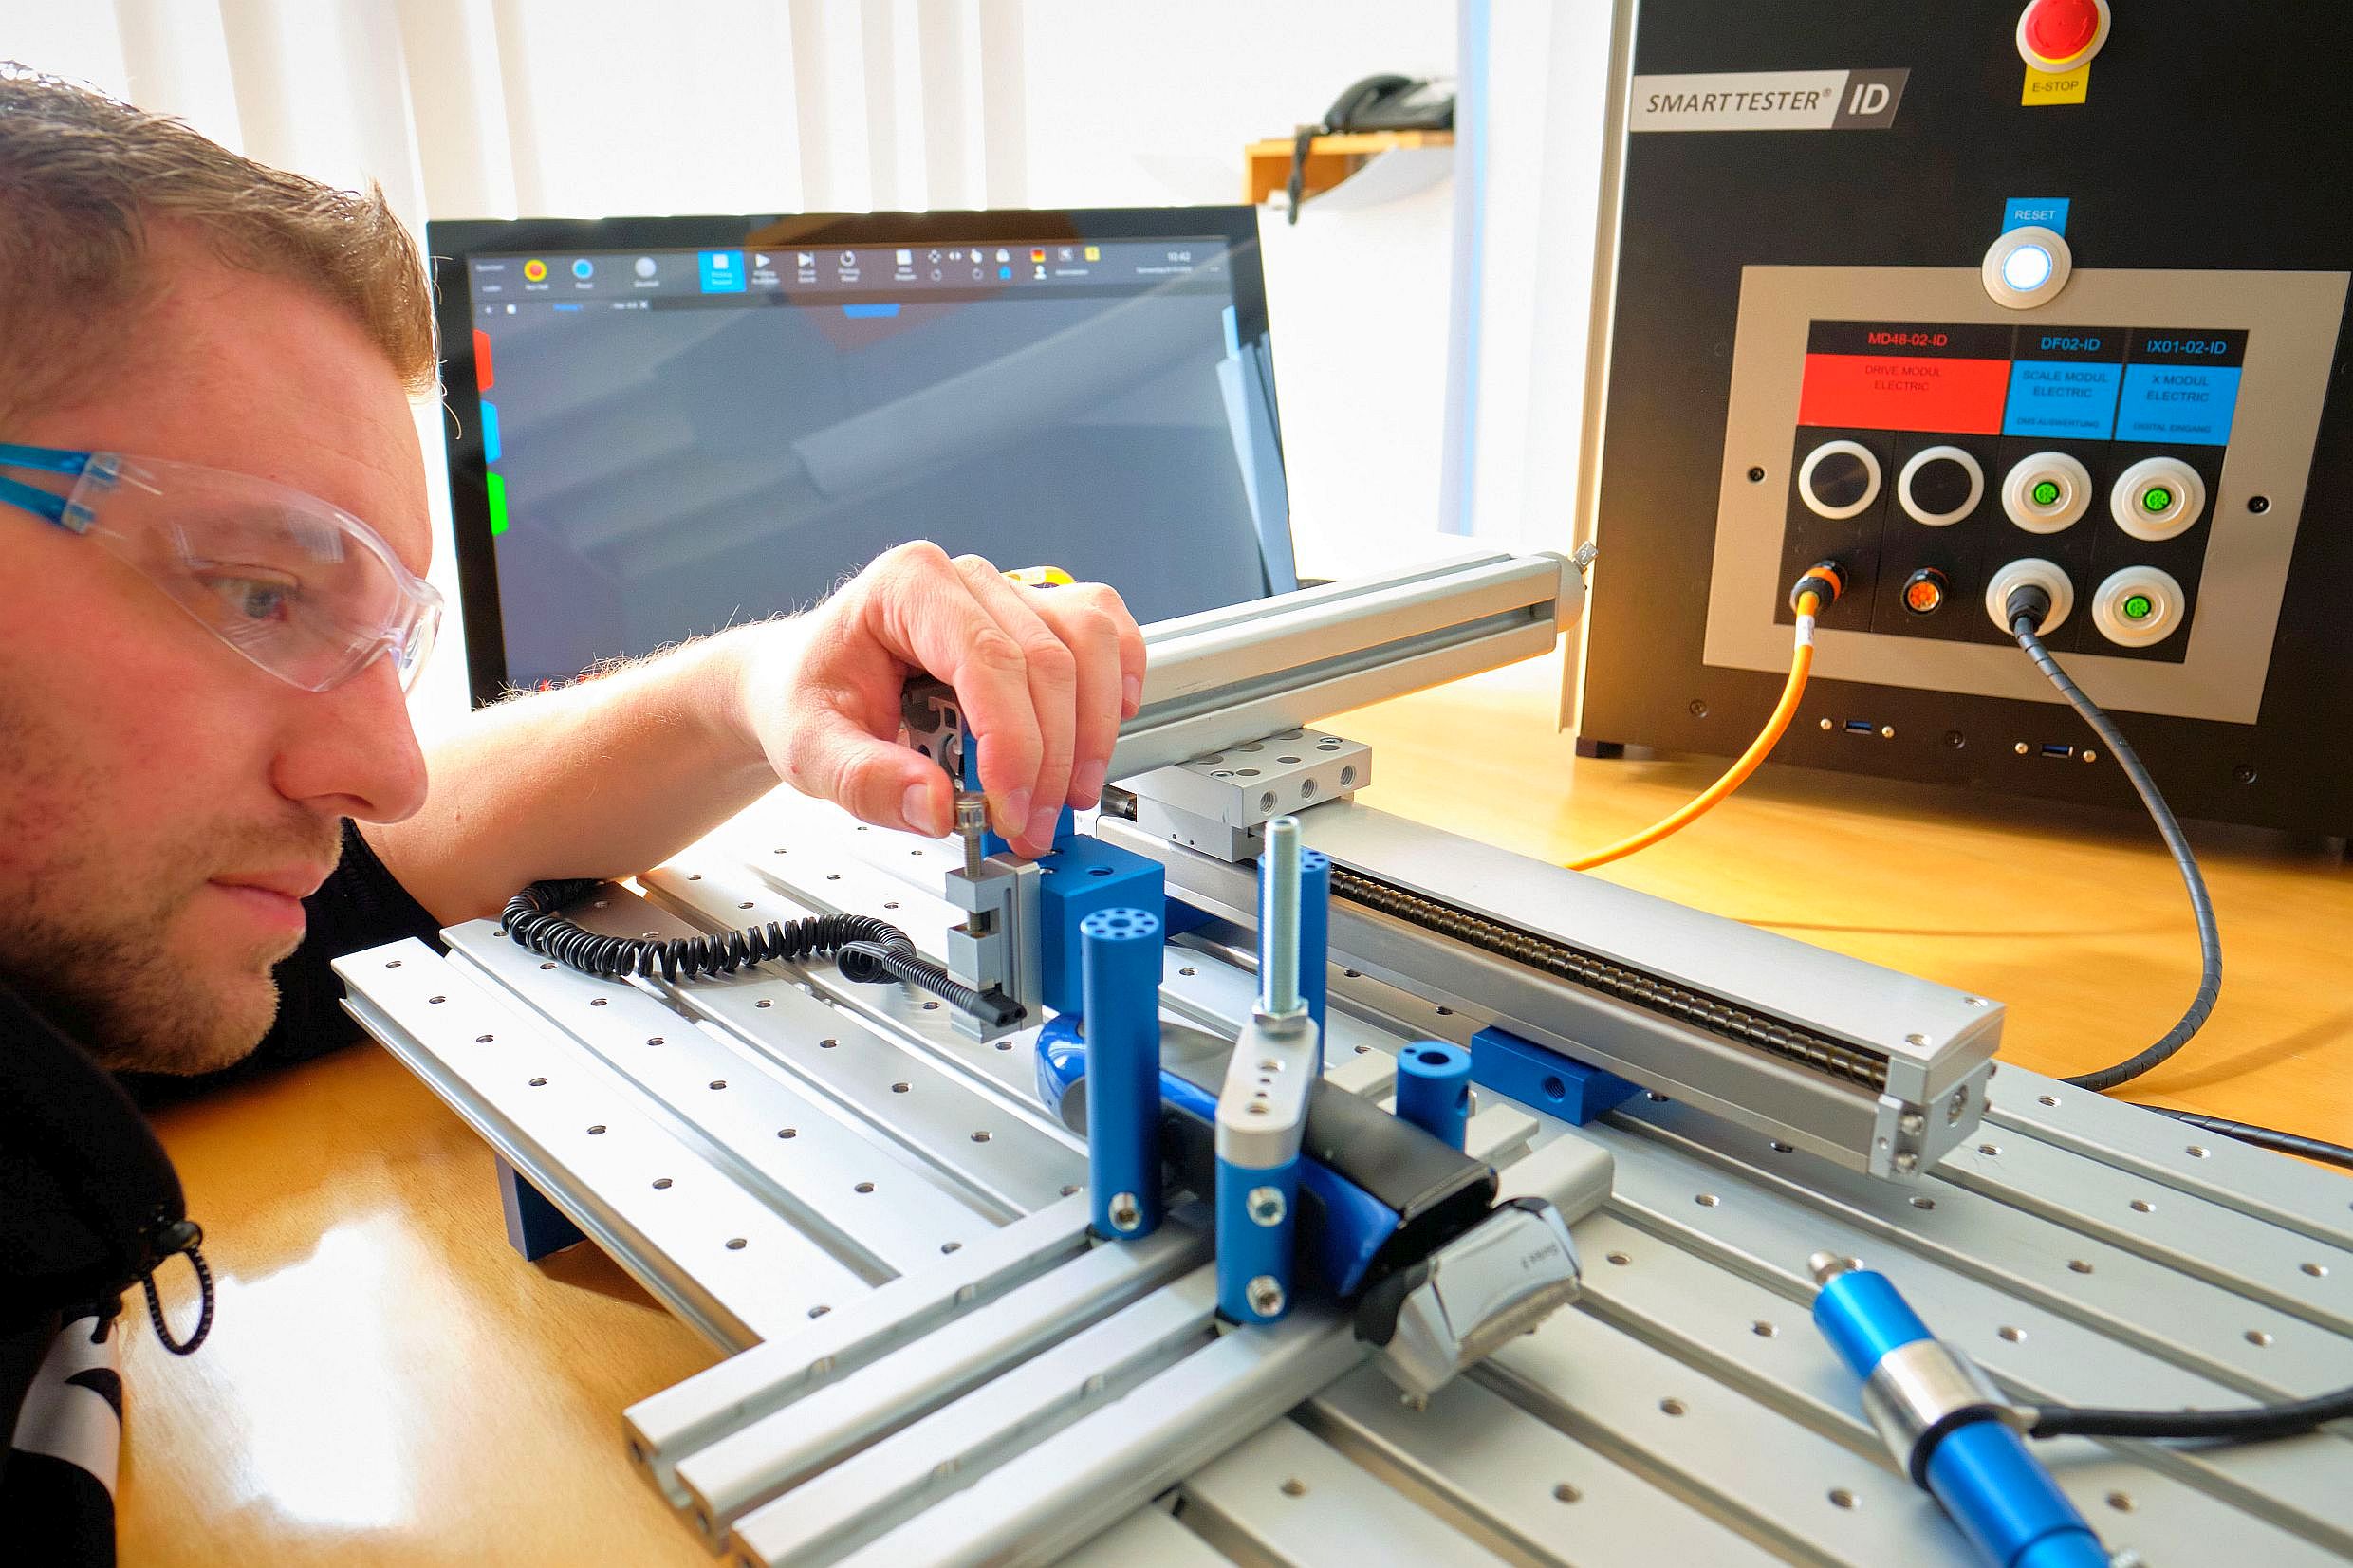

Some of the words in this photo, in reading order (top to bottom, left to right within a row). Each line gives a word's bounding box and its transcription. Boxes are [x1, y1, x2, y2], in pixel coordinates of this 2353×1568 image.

[2032, 81, 2079, 92] E-STOP
[1848, 83, 1891, 115] ID
[2014, 210, 2056, 220] RESET
[1867, 332, 1948, 347] MD48-02-ID
[2040, 336, 2101, 351] DF02-ID
[2146, 339, 2227, 355] IX01-02-ID
[1865, 365, 1899, 376] DRIVE
[1901, 366, 1942, 378] MODUL
[2022, 370, 2062, 381] SCALE
[2064, 371, 2109, 383] MODUL
[1874, 380, 1930, 392] ELECTRIC
[2162, 376, 2210, 387] MODUL
[2033, 385, 2093, 398] ELECTRIC
[2146, 389, 2210, 403] ELECTRIC
